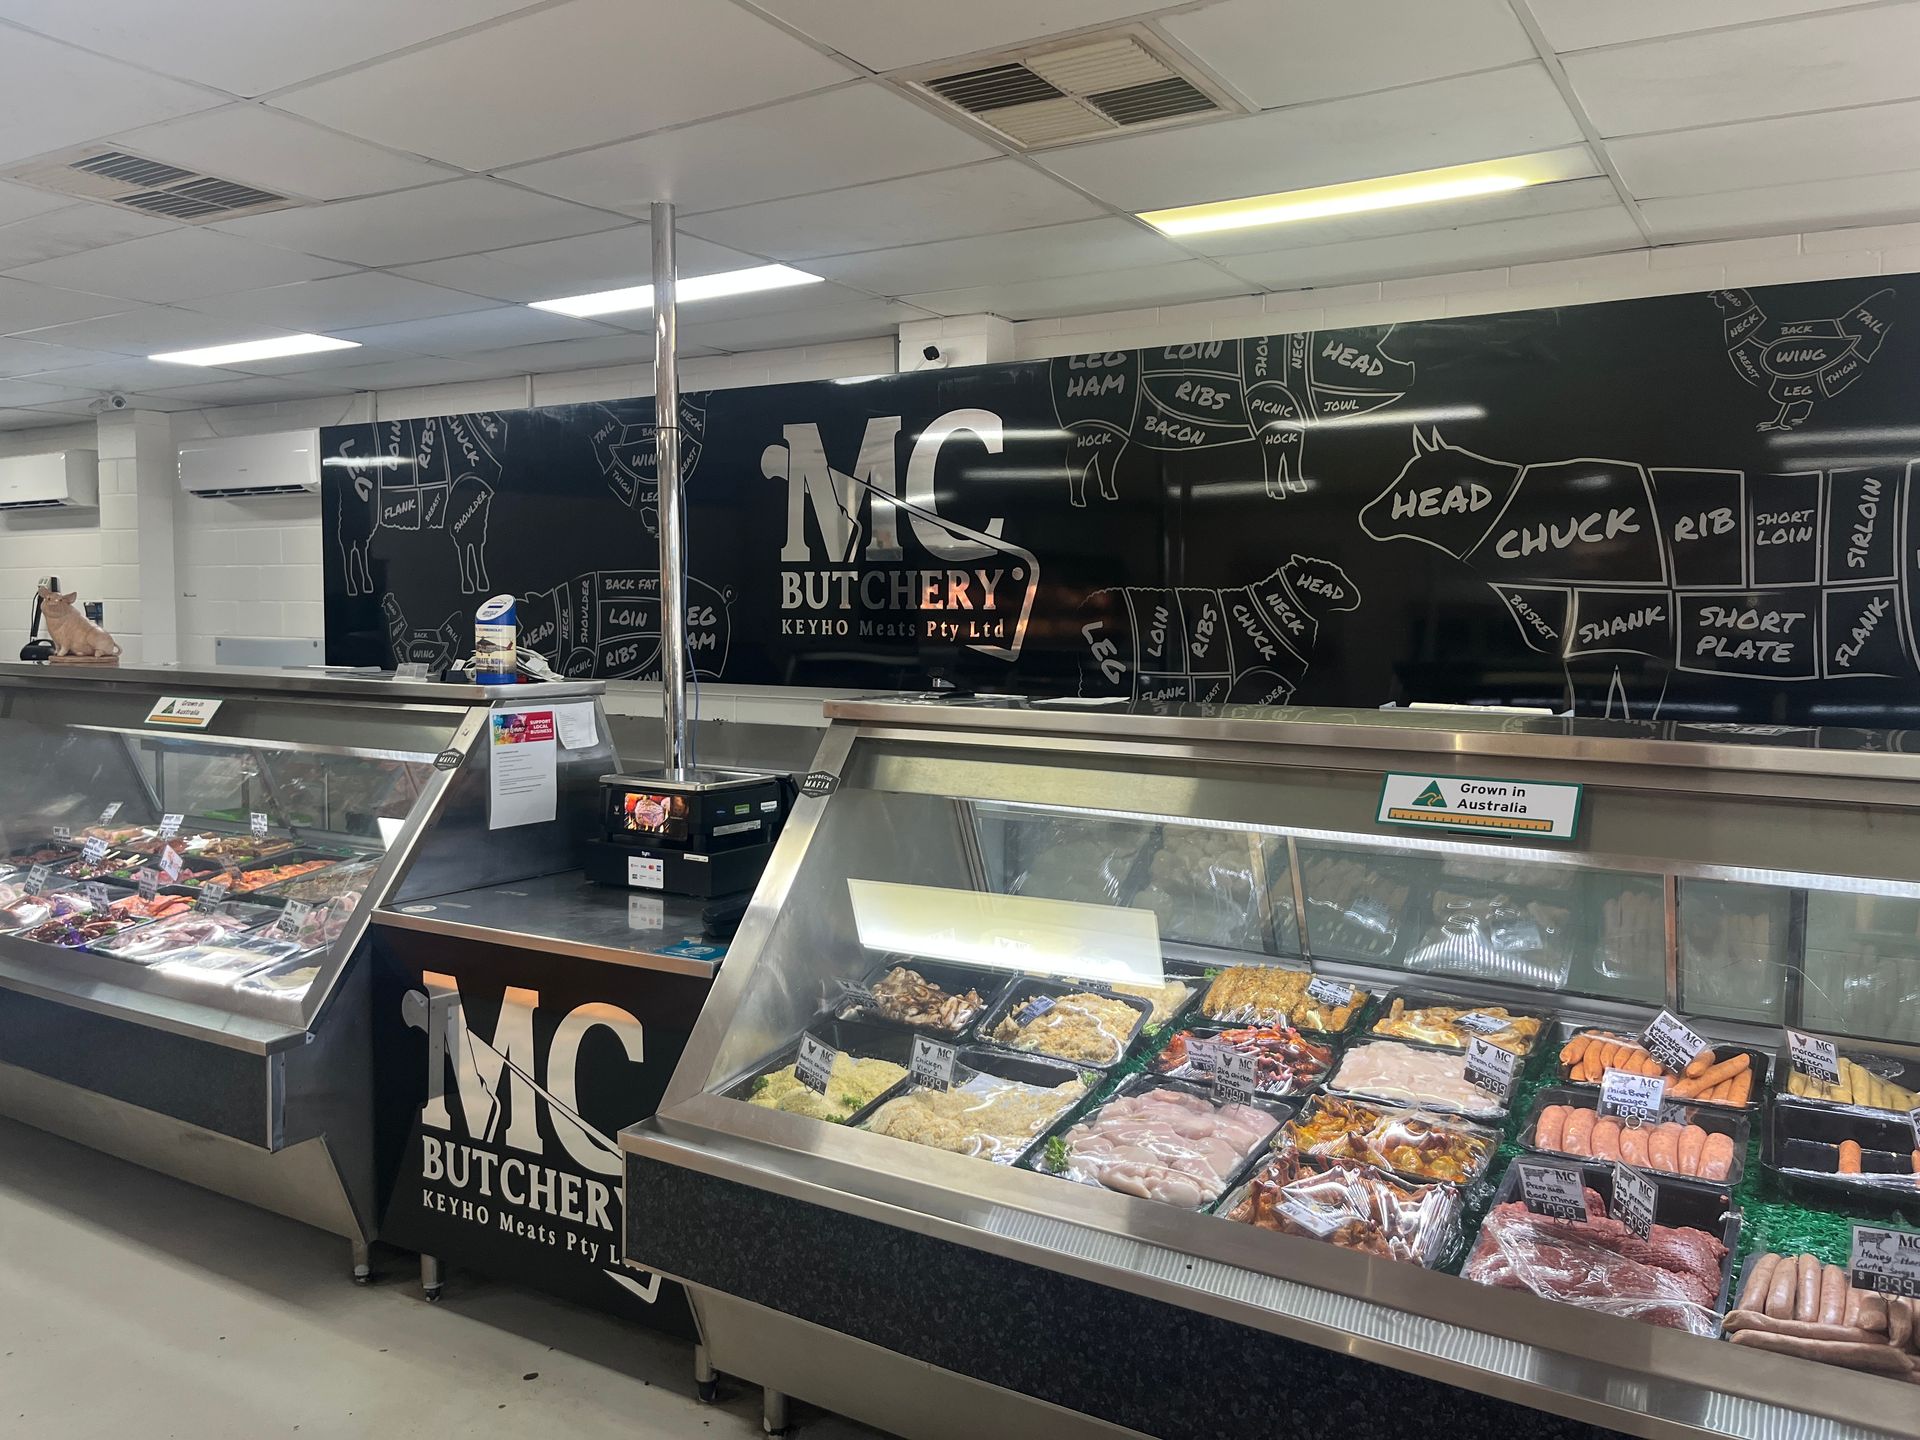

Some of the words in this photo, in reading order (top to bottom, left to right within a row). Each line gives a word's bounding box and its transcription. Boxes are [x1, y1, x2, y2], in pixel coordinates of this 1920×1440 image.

[1720, 290, 1742, 307] HEAD
[1730, 314, 1759, 337] NECK
[1781, 326, 1813, 335] BACK
[1856, 309, 1883, 334] TAIL
[1164, 341, 1223, 360] LOIN
[1321, 340, 1384, 376] HEAD
[1776, 349, 1826, 363] WING
[1736, 350, 1760, 379] BREAST
[1825, 361, 1857, 384] THIGH
[1067, 374, 1125, 397] HAM
[1175, 381, 1231, 410] RIBS
[1784, 386, 1813, 396] LEG
[1251, 399, 1293, 418] PICNIC
[1323, 400, 1360, 412] JOWL
[680, 409, 703, 431] NECK
[1144, 415, 1206, 444] BACON
[593, 421, 615, 443] TAIL
[641, 428, 657, 436] BAC
[1077, 433, 1112, 447] HOCK
[1265, 432, 1298, 444] HOCK
[418, 417, 436, 469] RIBS
[631, 453, 657, 467] WIN
[681, 446, 697, 474] REAST
[612, 469, 633, 495] THIGH
[781, 408, 1004, 563] MC
[384, 499, 416, 520] FLANK
[424, 493, 442, 522] BREAST
[453, 491, 488, 533] SHOULDER
[1391, 484, 1492, 520] HEAD
[1675, 508, 1736, 542] RIB
[1757, 510, 1815, 526] SHORT
[1847, 477, 1882, 568] SIRLOIN
[1496, 507, 1640, 560] CHUCK
[1757, 526, 1814, 546] LOIN
[605, 579, 635, 590] BACK
[638, 578, 659, 590] FAT
[781, 569, 1004, 610] BUTCHERY
[1296, 573, 1345, 600] HEAD
[580, 580, 590, 643] SHOULDER
[609, 608, 648, 627] LOIN
[686, 606, 717, 626] EG
[1265, 593, 1305, 636] NECK
[1510, 594, 1559, 640] BRISKET
[1699, 606, 1806, 635] SHORT
[445, 624, 458, 642] TAIL
[523, 621, 555, 649] HEAD
[781, 619, 849, 636] KEYHO
[859, 620, 916, 637] Meats
[926, 620, 960, 642] Pty
[970, 618, 1005, 638] Ltd
[1147, 605, 1169, 657] LOIN
[1193, 603, 1217, 658] RIBS
[1232, 604, 1278, 661] CHUCK
[1577, 606, 1667, 643] SHANK
[1835, 597, 1890, 667] FLANK
[686, 631, 716, 650] AM
[1696, 636, 1795, 663] PLATE
[413, 650, 435, 659] WING
[606, 643, 638, 668] RIBS
[1081, 621, 1127, 685] LEG
[569, 658, 592, 676] PICNIC
[1141, 686, 1186, 701] FLANK
[804, 780, 829, 789] MAFIA
[1460, 783, 1507, 797] Grown
[1512, 787, 1526, 797] in
[1456, 799, 1527, 814] Australia
[1682, 1030, 1702, 1048] MC
[1814, 1039, 1832, 1053] MC
[936, 1046, 952, 1060] MC
[1238, 1057, 1252, 1070] MC
[1494, 1048, 1511, 1063] MC
[1791, 1045, 1832, 1064] moroccan
[421, 969, 644, 1177] MC
[1640, 1077, 1659, 1089] MC
[1606, 1093, 1648, 1107] Sausages
[1627, 1088, 1650, 1099] Beef
[1554, 1170, 1576, 1182] MC
[1638, 1178, 1652, 1199] MC
[1549, 1194, 1580, 1206] Mince
[422, 1189, 489, 1225] KEYHO
[499, 1211, 556, 1246] Meats
[566, 1231, 599, 1263] Pty
[1898, 1235, 1920, 1249] MC
